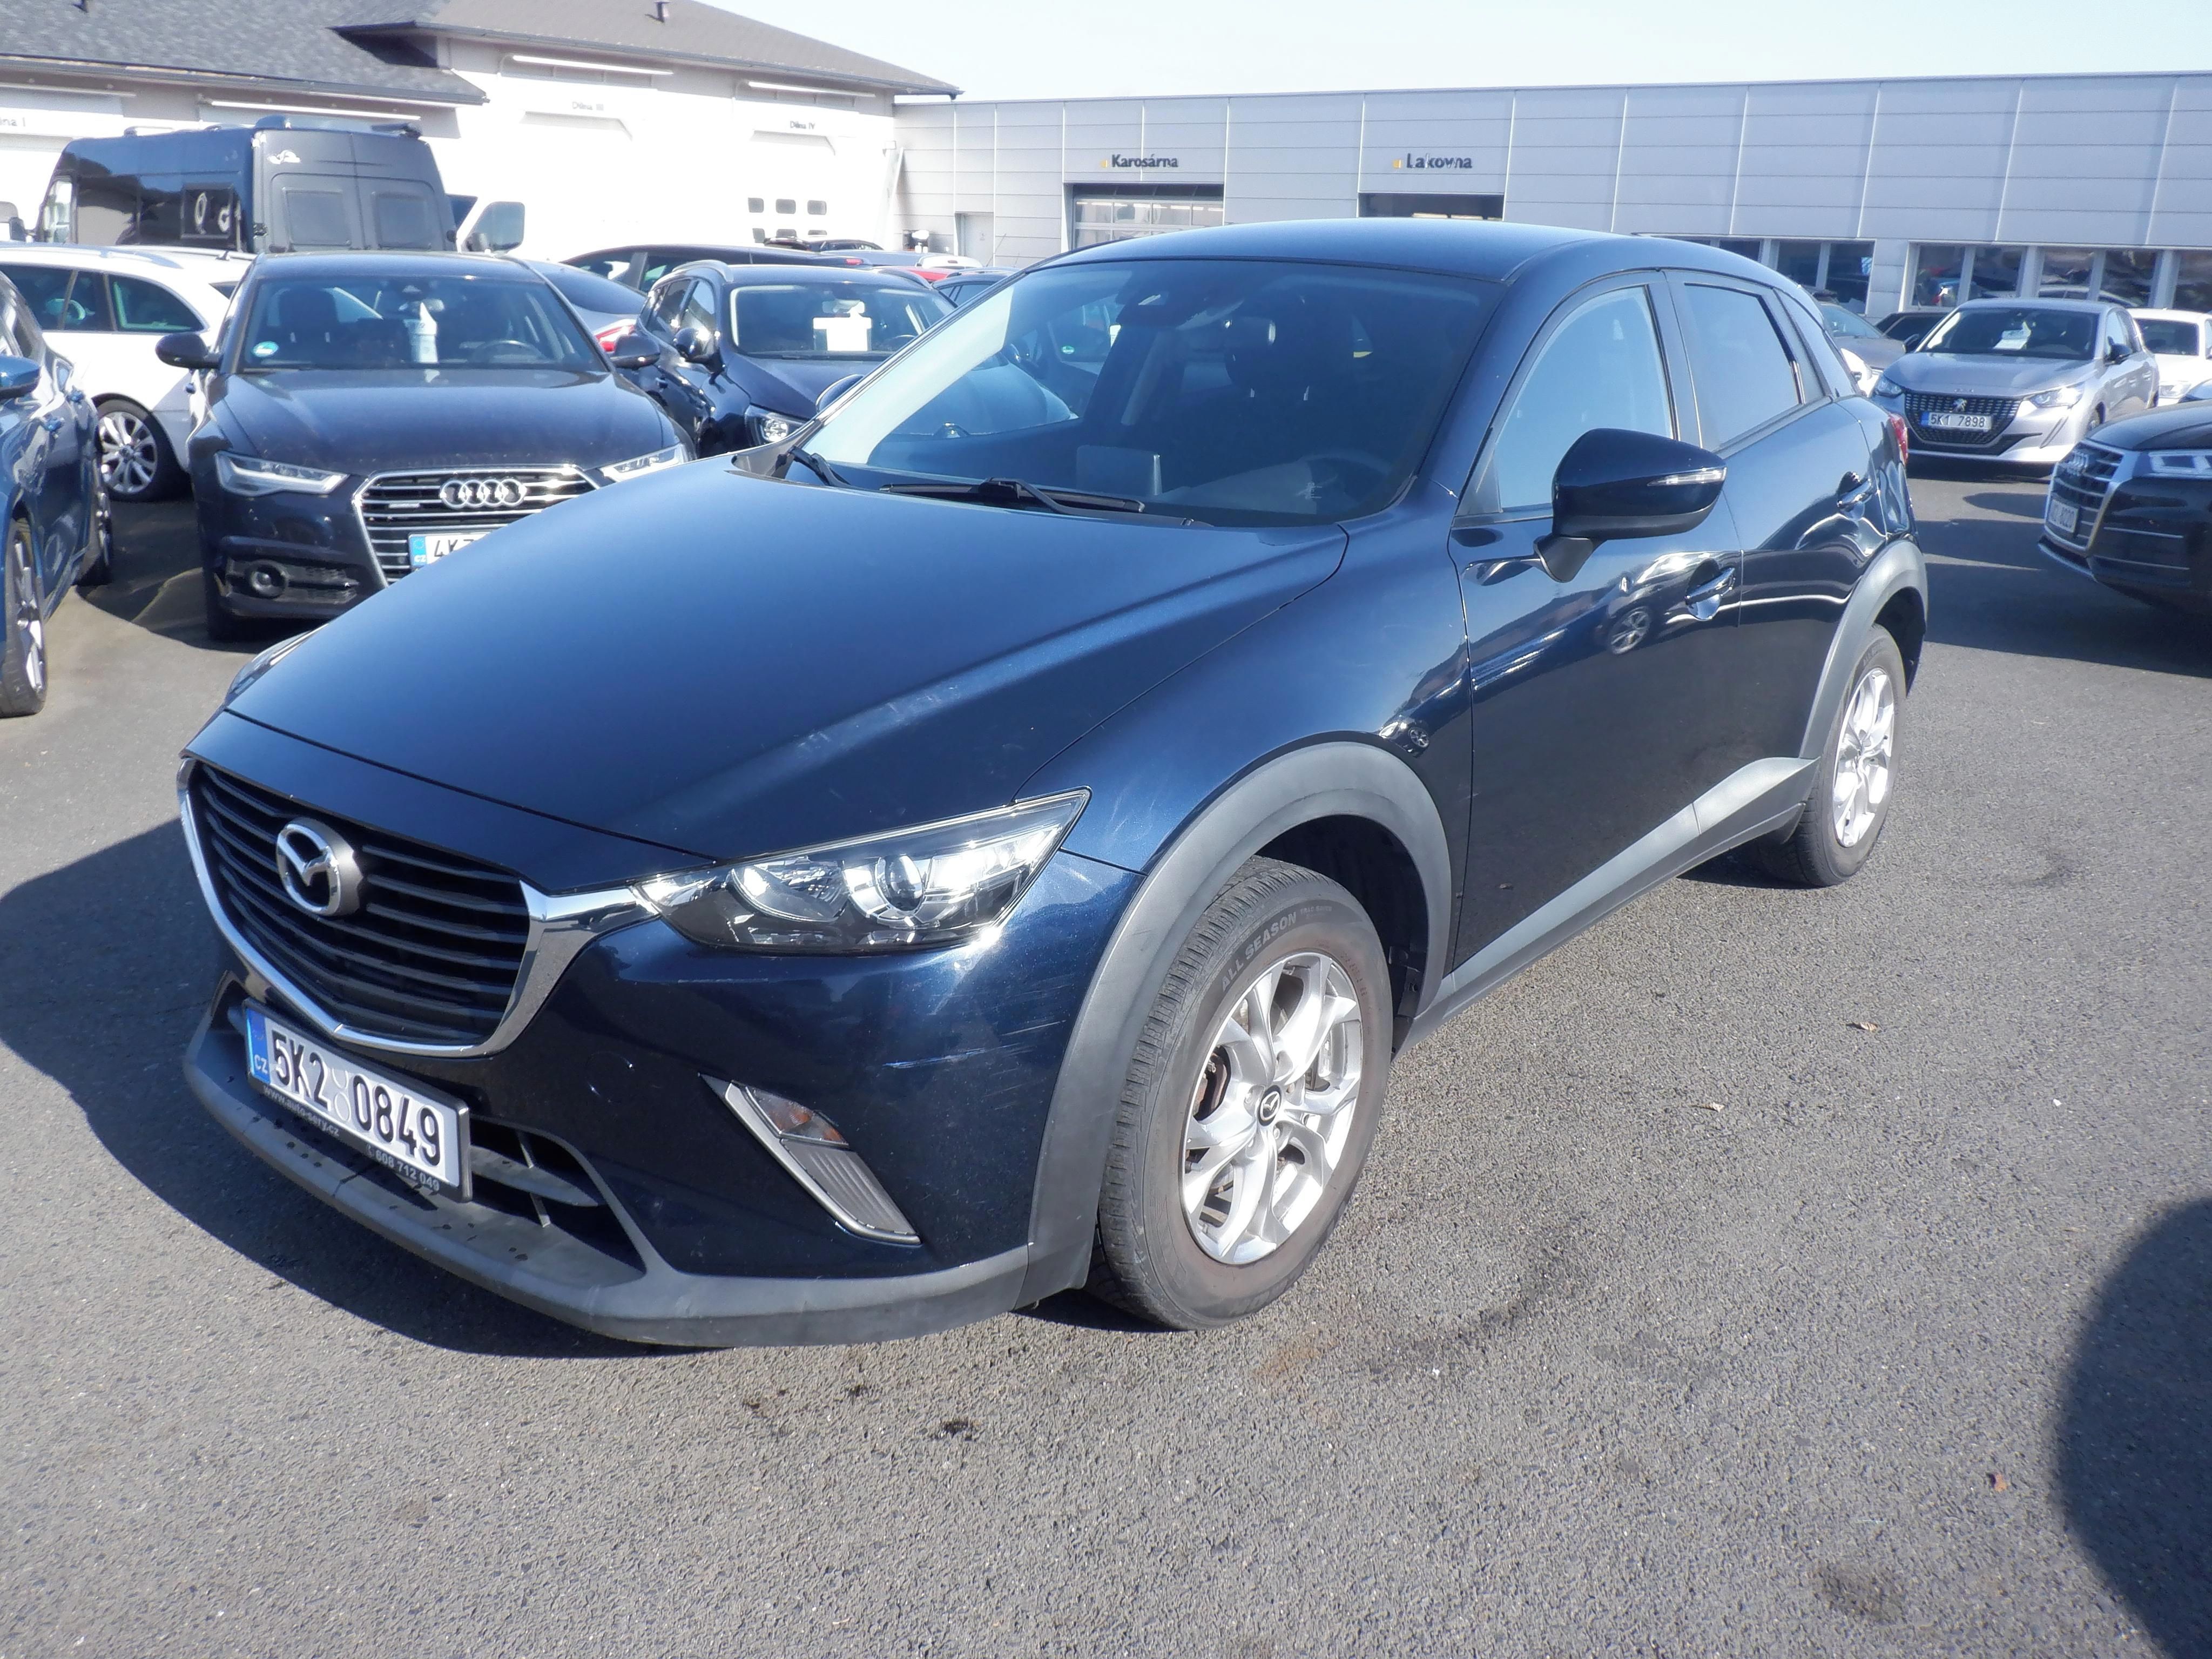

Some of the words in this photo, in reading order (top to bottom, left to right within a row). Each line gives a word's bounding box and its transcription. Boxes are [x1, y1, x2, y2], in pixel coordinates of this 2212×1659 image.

[1112, 153, 1178, 167] Karosárna
[1406, 153, 1472, 168] Lakovna
[1931, 414, 1950, 426] 5K1
[1958, 416, 1985, 428] 7898
[1222, 959, 1244, 992] ALL
[1245, 912, 1296, 960] SEASON
[254, 1055, 268, 1074] CZ
[272, 1029, 329, 1110] 5K2
[353, 1075, 441, 1166] 0849
[376, 1149, 395, 1169] 608
[397, 1161, 417, 1180] 712
[419, 1170, 440, 1191] 049
